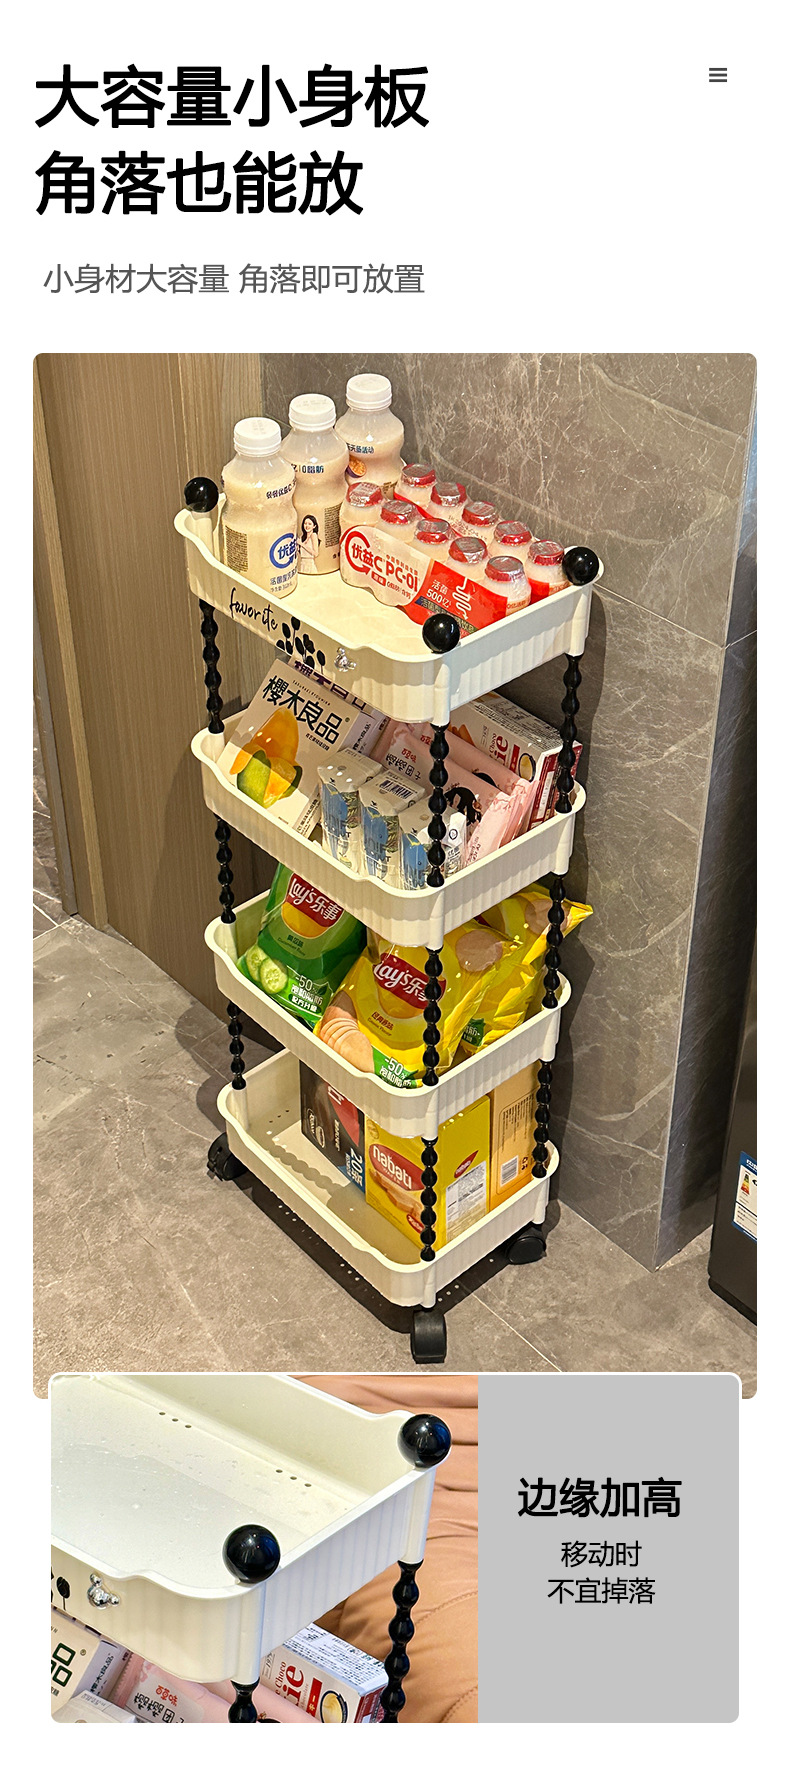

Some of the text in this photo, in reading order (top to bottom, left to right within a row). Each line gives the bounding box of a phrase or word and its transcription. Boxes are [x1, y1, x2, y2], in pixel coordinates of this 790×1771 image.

[229, 587, 278, 632] favorite
[262, 675, 343, 745] 櫻木良品
[494, 735, 508, 767] ie
[372, 1145, 413, 1190] nabati
[275, 1661, 287, 1689] Choco
[283, 1665, 305, 1707] ie
